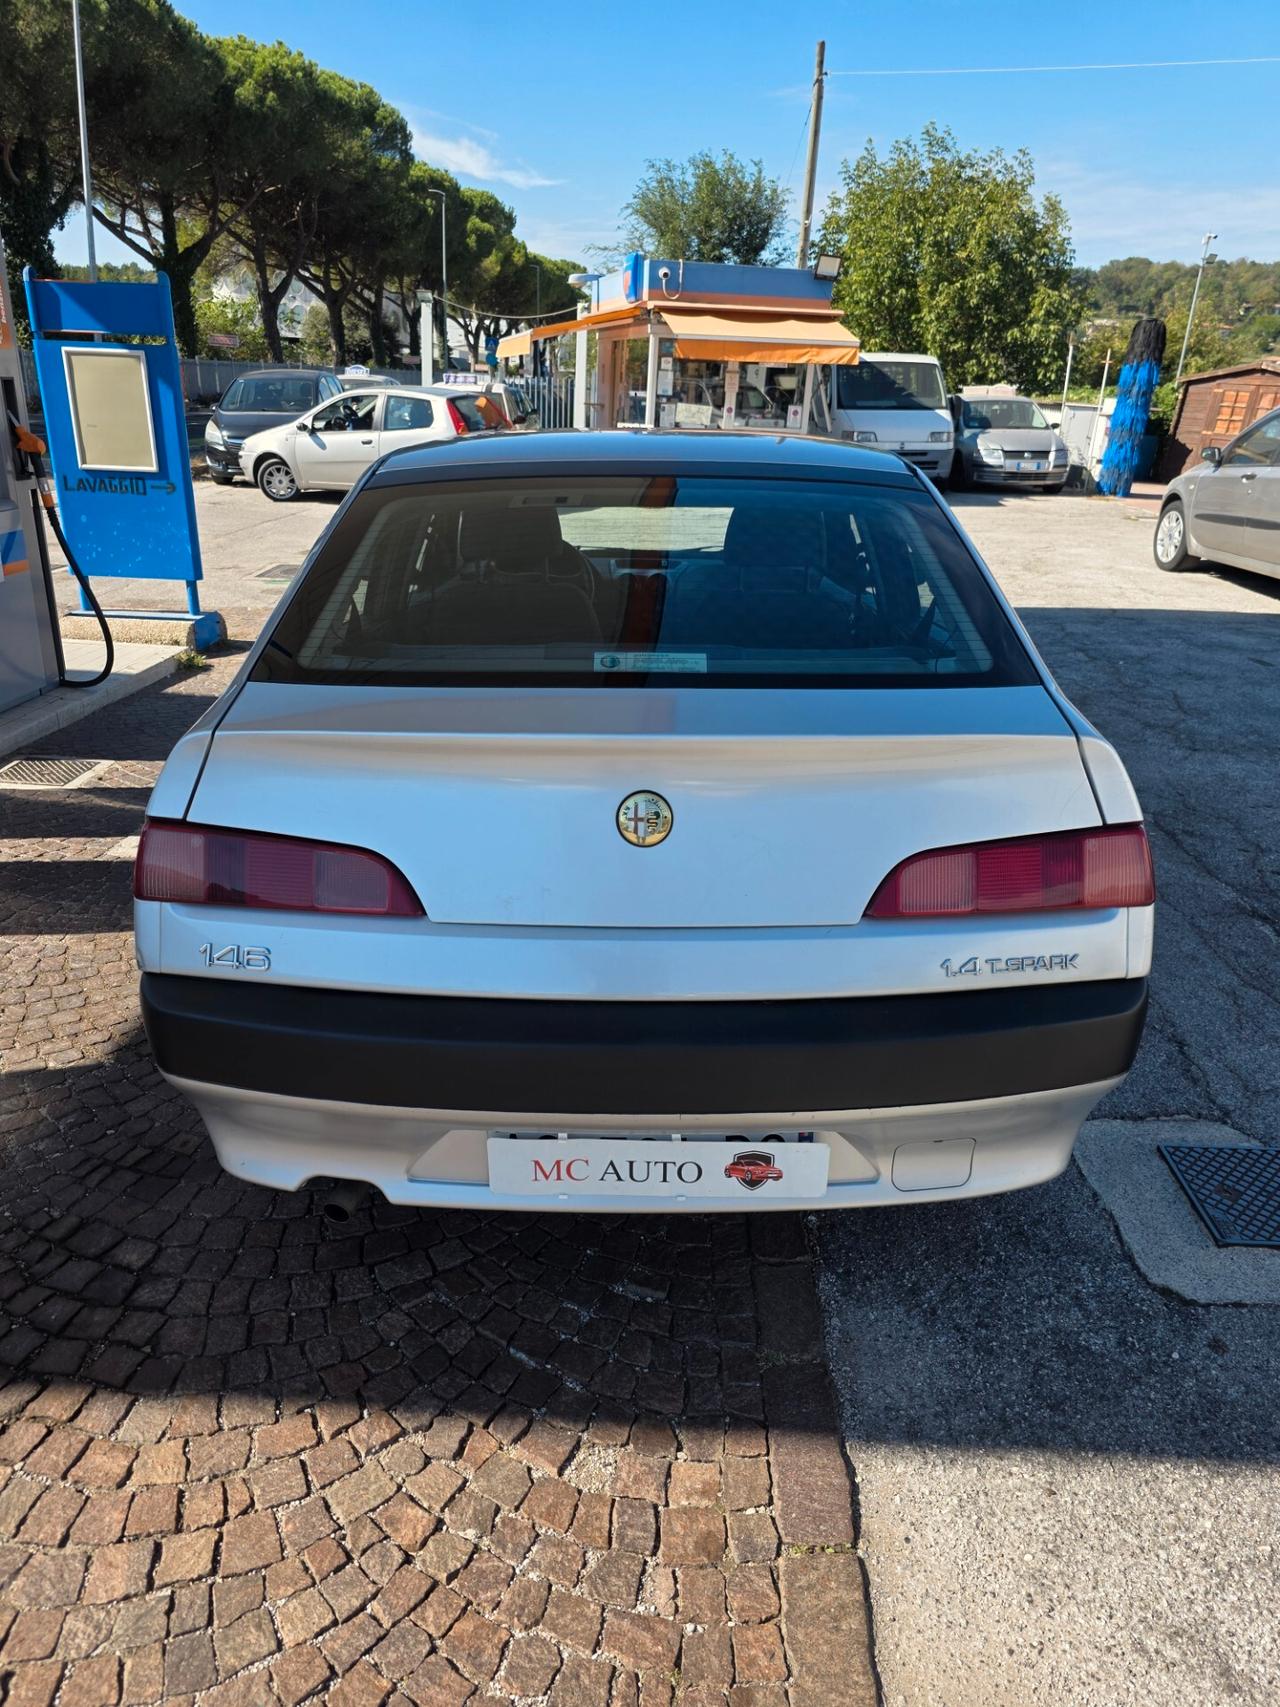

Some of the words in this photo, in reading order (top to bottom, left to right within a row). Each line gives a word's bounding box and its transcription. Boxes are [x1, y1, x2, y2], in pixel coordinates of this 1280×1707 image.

[63, 475, 147, 496] LAVAGGIO
[199, 943, 271, 971] 146
[940, 957, 981, 977] 1.4
[985, 953, 1079, 974] T.SPARK
[531, 1158, 590, 1182] MC
[599, 1160, 703, 1184] AUTO
